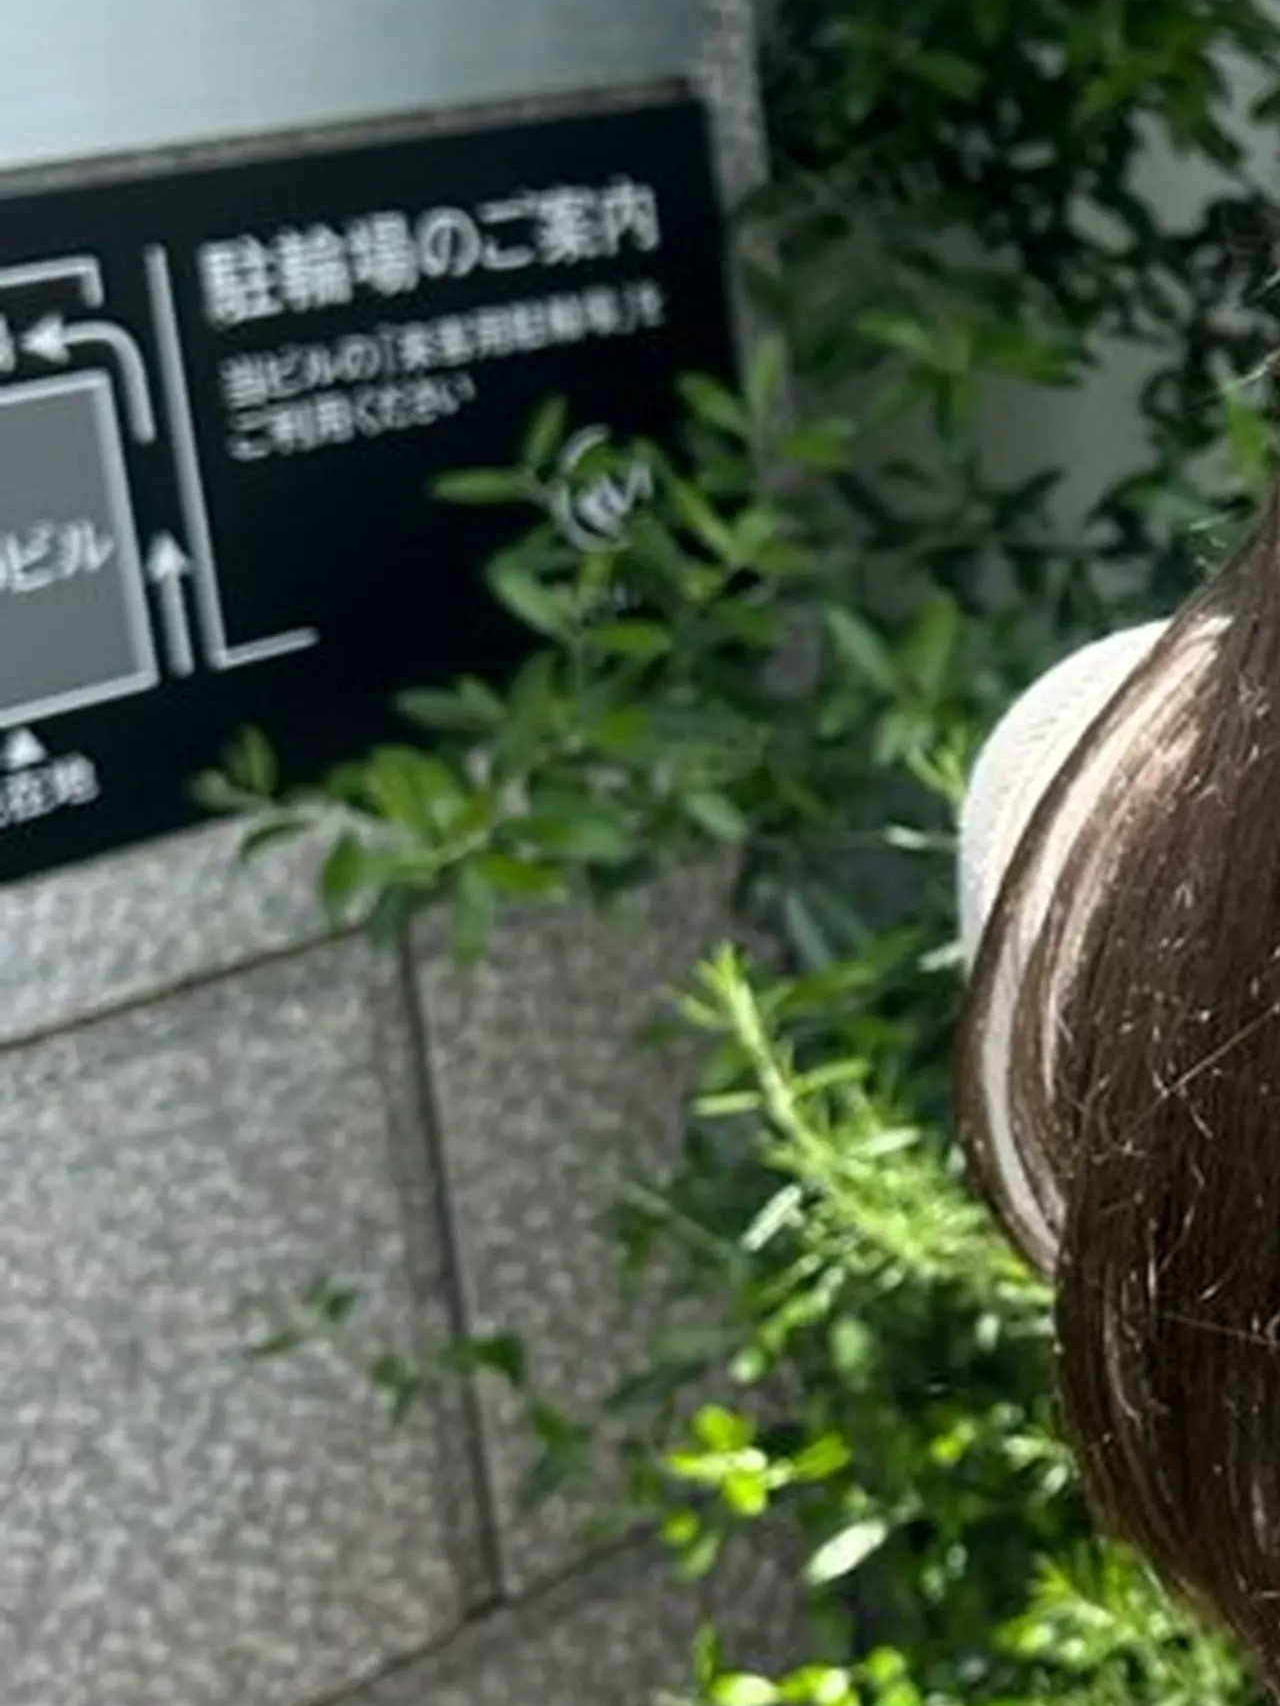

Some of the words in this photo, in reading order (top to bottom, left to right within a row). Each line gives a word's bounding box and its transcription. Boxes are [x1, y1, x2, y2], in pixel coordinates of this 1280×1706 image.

[199, 174, 661, 329] 駐輪場のご案内
[227, 371, 476, 460] ご利用ください
[0, 519, 114, 591] ビル
[0, 753, 101, 829] 在地
